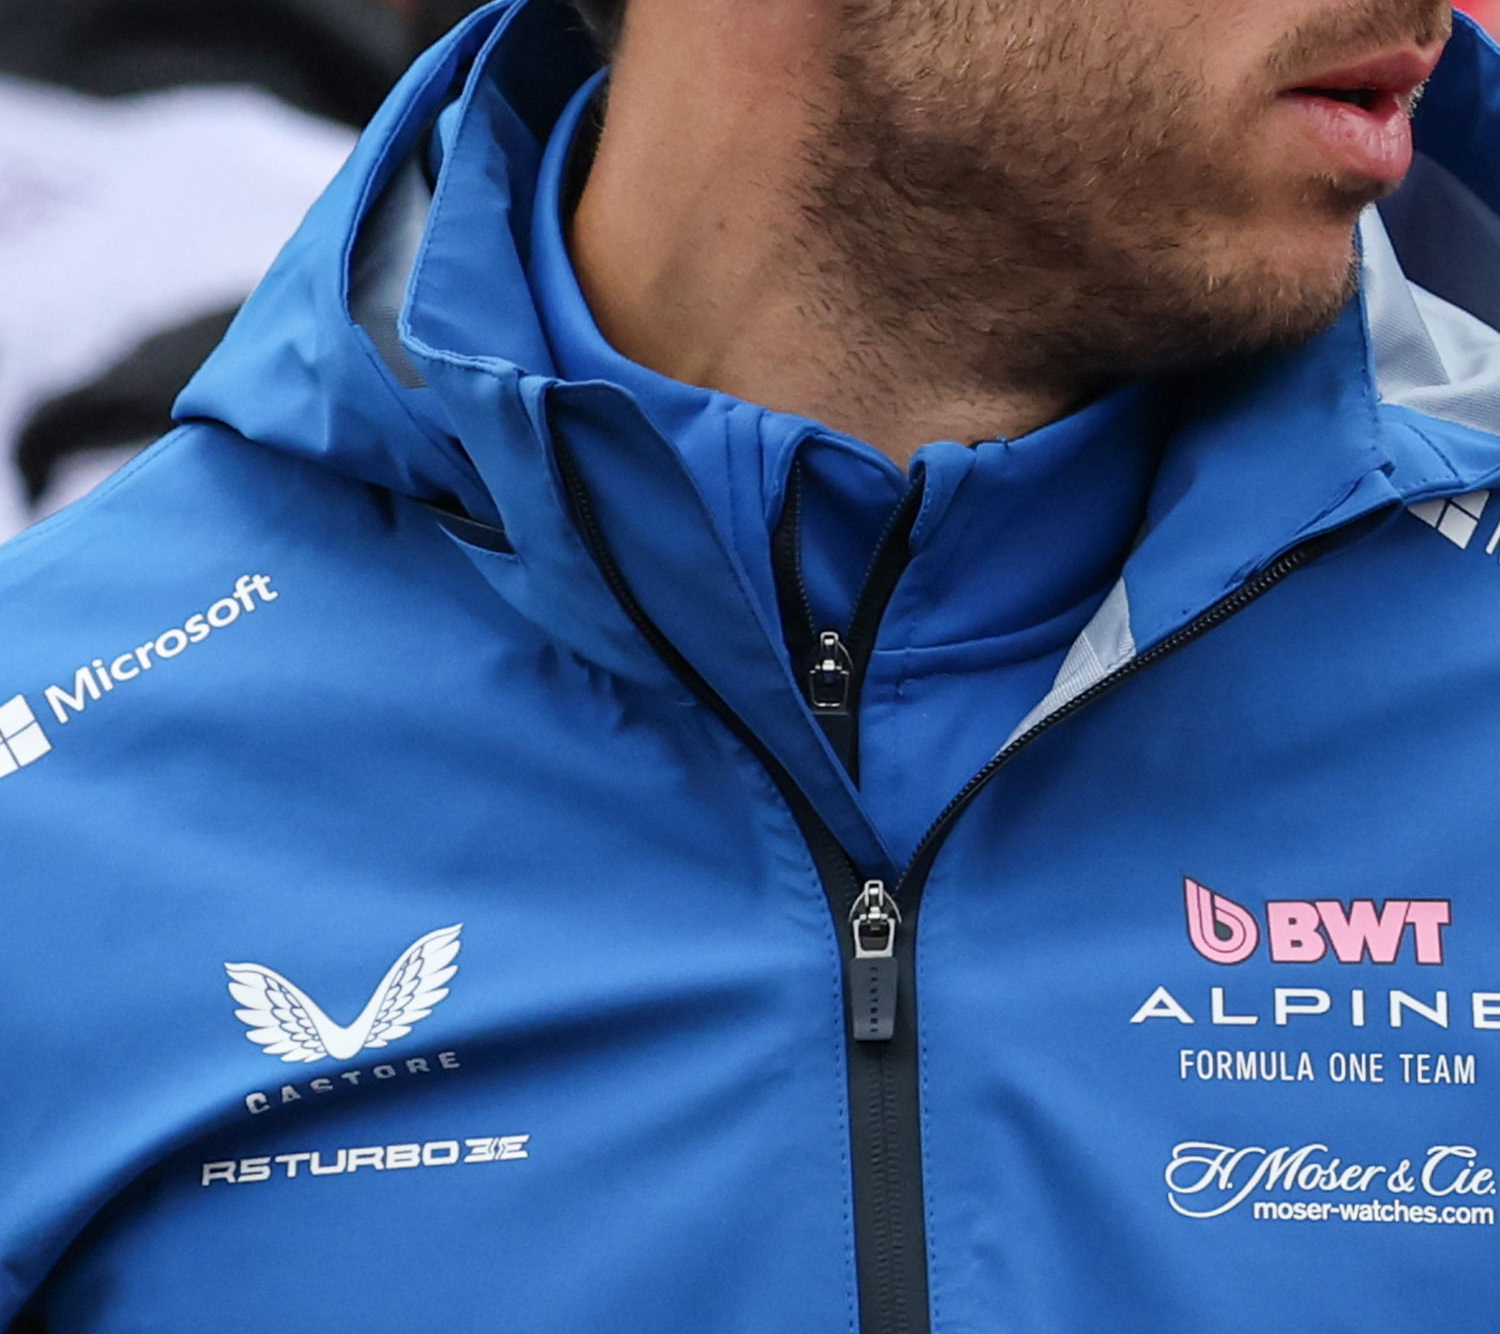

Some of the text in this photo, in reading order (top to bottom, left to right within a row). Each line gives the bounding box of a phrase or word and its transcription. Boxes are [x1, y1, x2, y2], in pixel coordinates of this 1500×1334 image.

[44, 573, 279, 724] Microsoft
[1265, 897, 1452, 966] BWT
[244, 1050, 462, 1115] CASTORE
[1179, 1049, 1477, 1085] FORMULA ONE TEAM
[1386, 1158, 1416, 1194] &
[1421, 1144, 1497, 1196] Cie.
[1252, 1199, 1496, 1225] moser-watches.com
